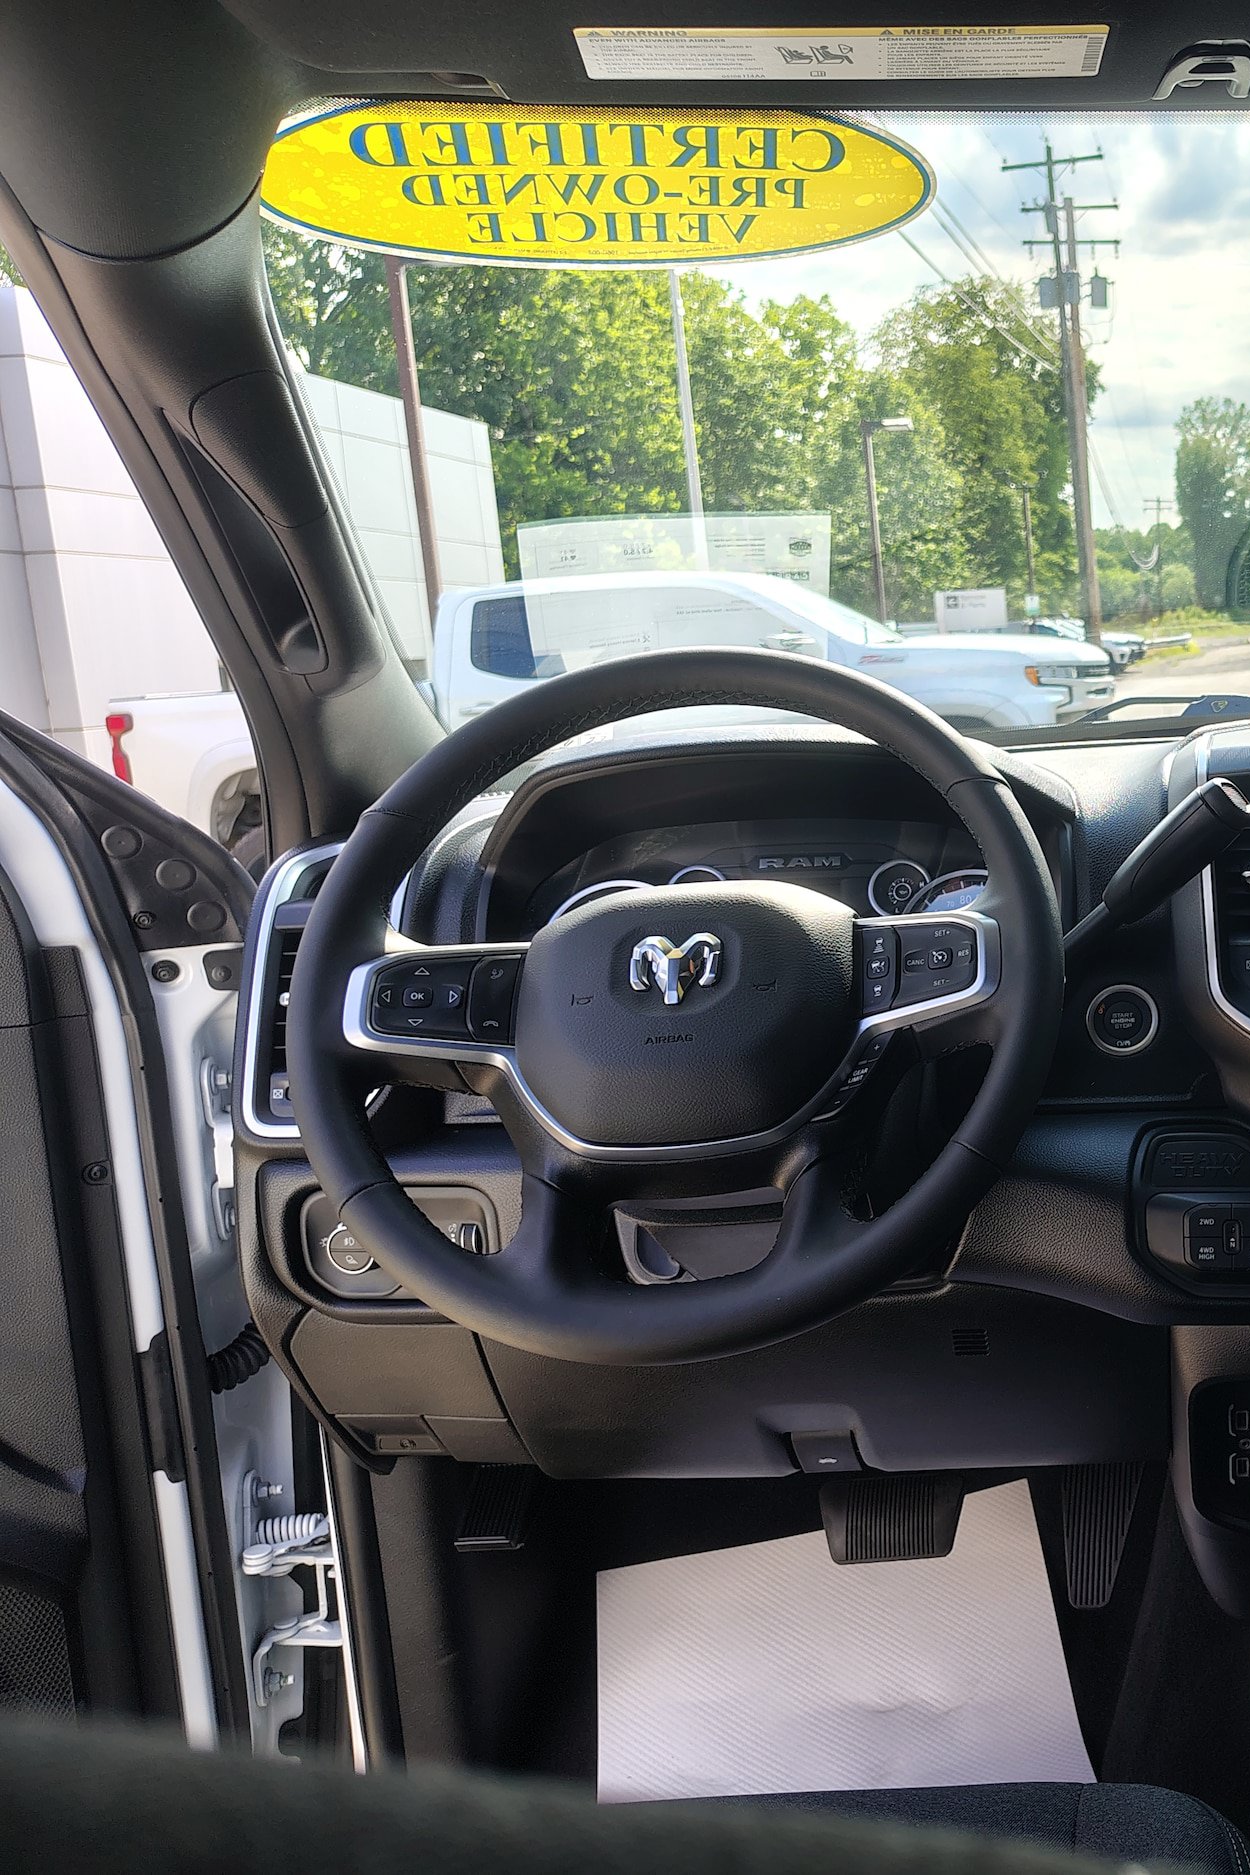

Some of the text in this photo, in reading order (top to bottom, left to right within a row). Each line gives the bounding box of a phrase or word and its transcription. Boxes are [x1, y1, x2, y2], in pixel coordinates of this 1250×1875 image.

[966, 27, 1016, 35] GARDE
[758, 856, 841, 869] RAM
[959, 894, 972, 905] 80
[958, 949, 970, 957] RES
[907, 958, 925, 966] CANC
[410, 992, 425, 1000] OK
[645, 1033, 694, 1045] AIRBAG
[853, 1067, 869, 1077] GEAR
[848, 1074, 864, 1084] LIMIT
[1160, 1152, 1244, 1165] HEAVY
